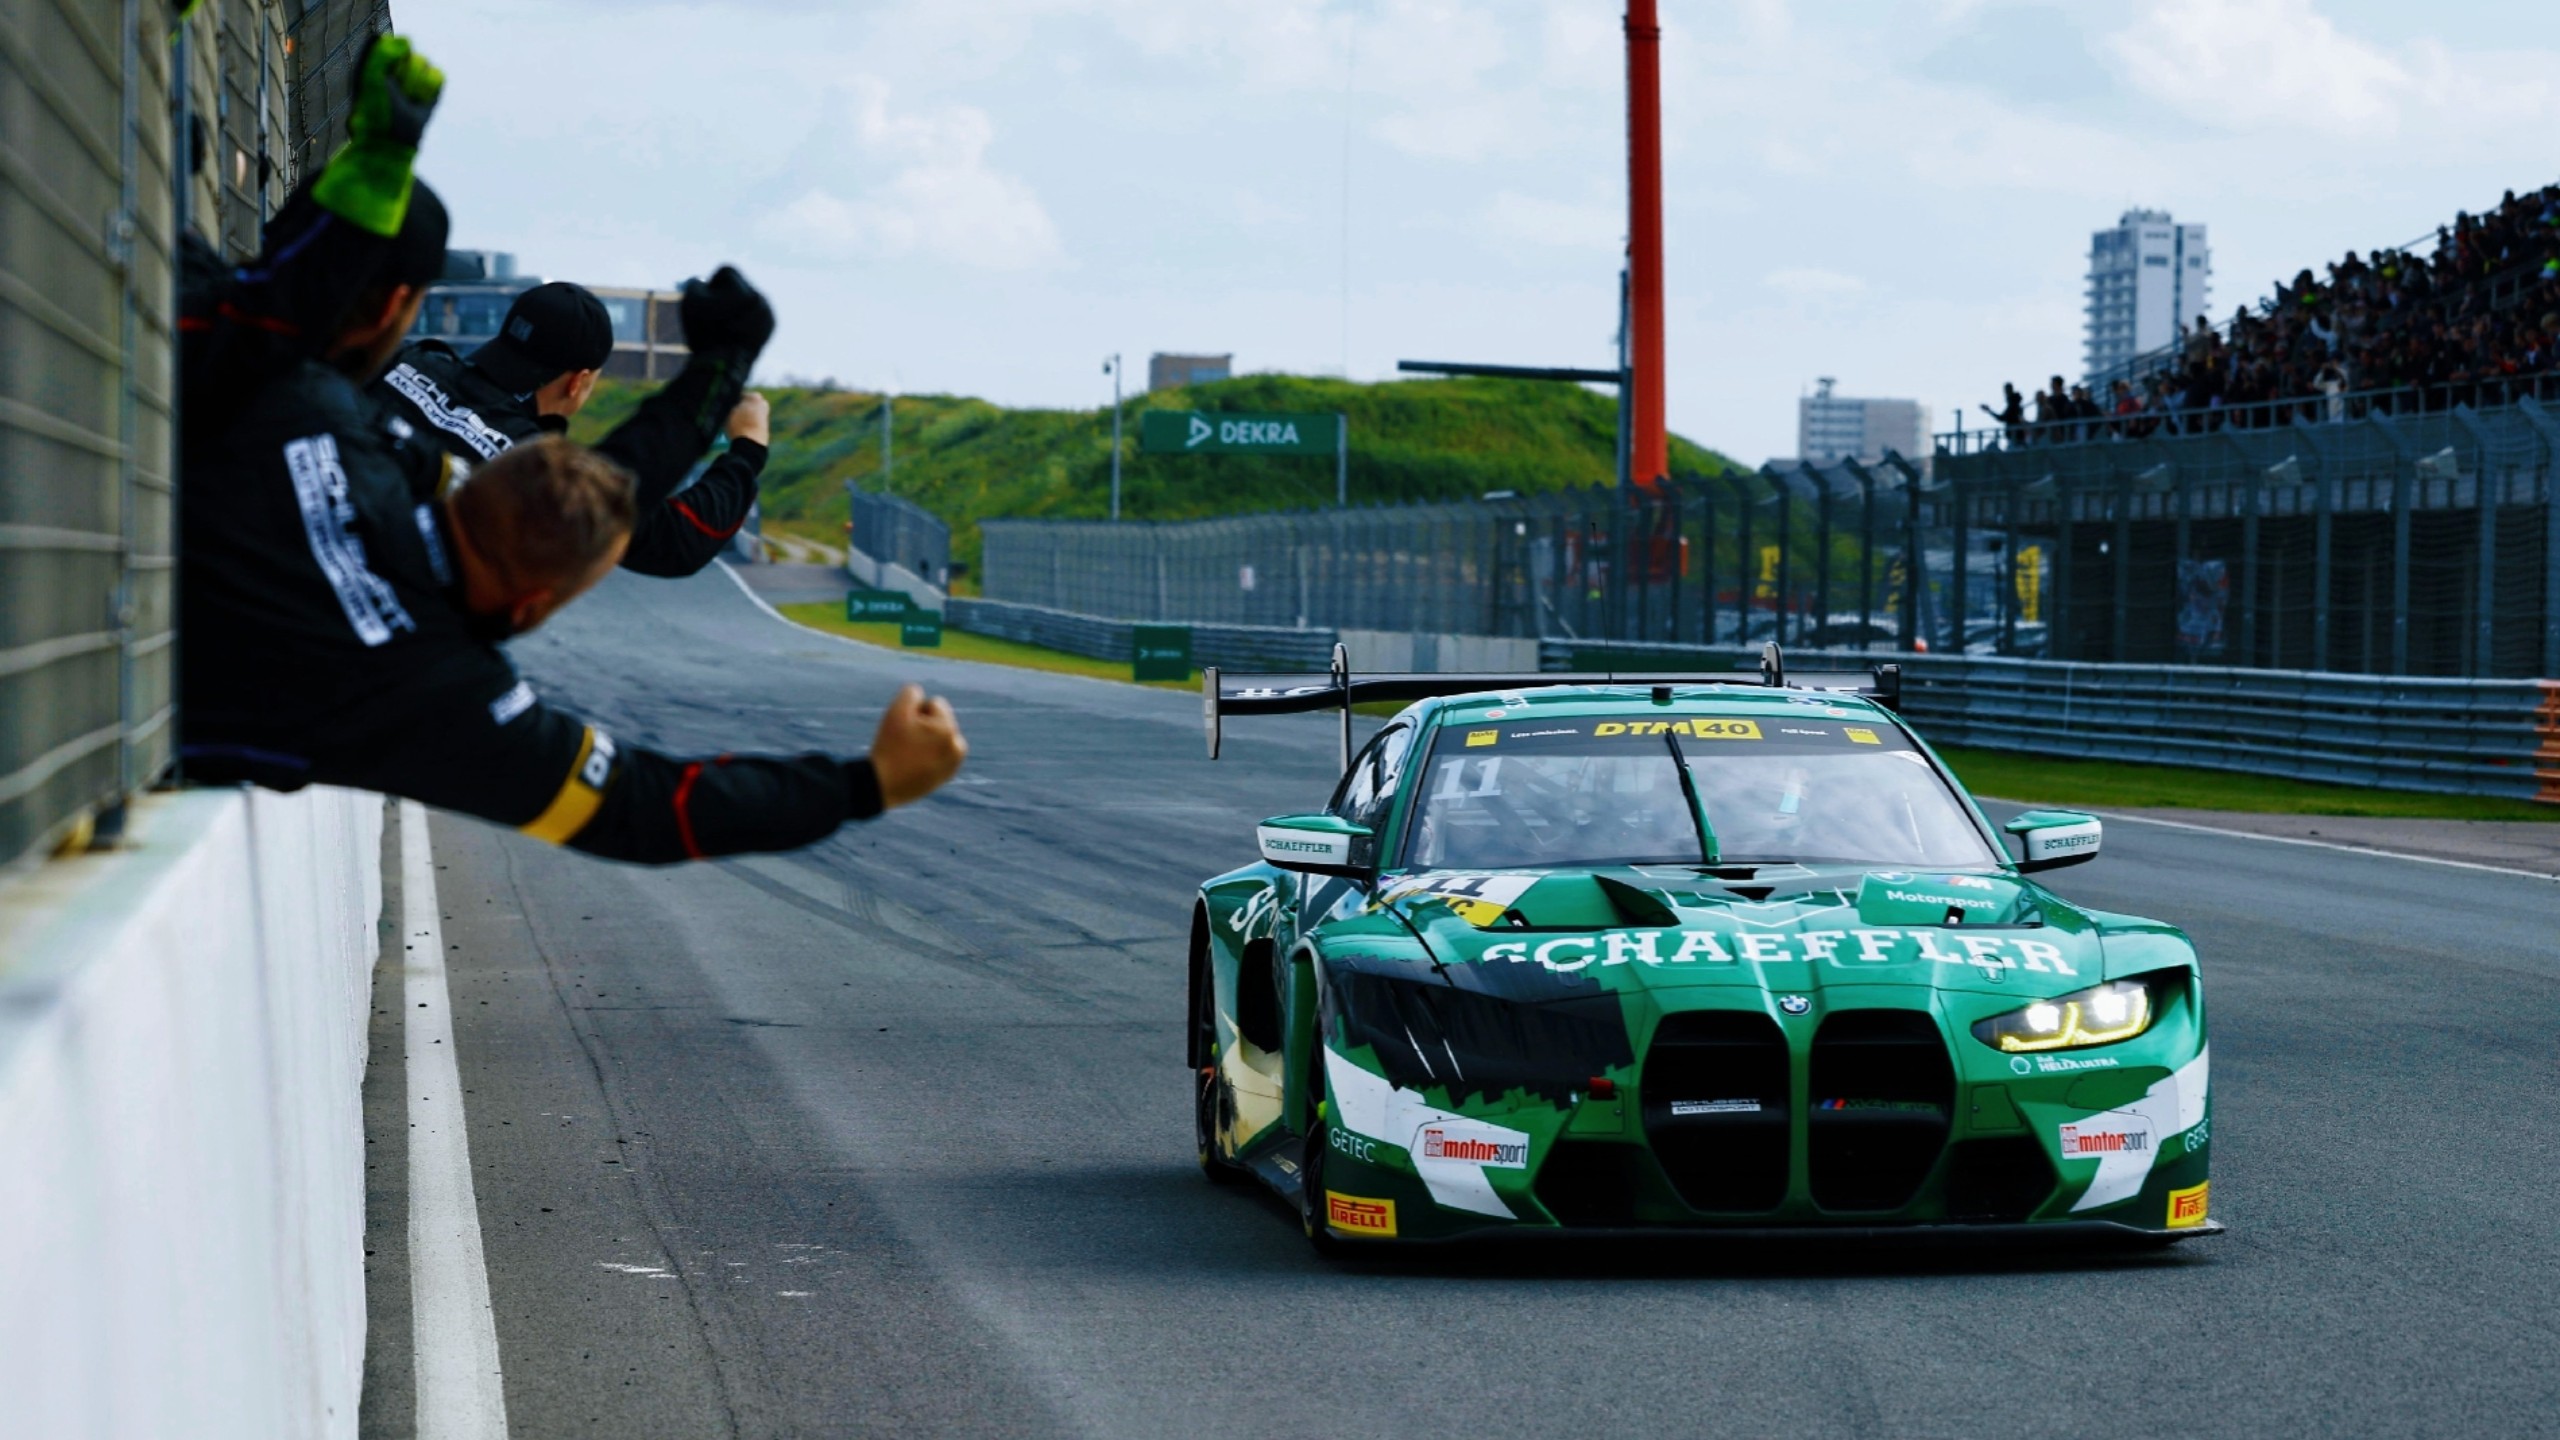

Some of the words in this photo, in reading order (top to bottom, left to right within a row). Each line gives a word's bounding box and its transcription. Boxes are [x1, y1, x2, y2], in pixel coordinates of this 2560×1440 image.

[1220, 420, 1300, 444] DEKRA
[1593, 721, 1692, 737] DTM
[1702, 722, 1751, 736] 40
[1430, 756, 1503, 800] 11
[1264, 839, 1334, 854] SCHAEFFLER
[1886, 889, 1996, 910] Motorsport
[1481, 929, 2077, 977] SCHAEFFLER
[1330, 1127, 1376, 1163] GETEC
[1443, 1139, 1527, 1165] motorsport
[2078, 1129, 2148, 1154] motorsport
[1330, 1197, 1387, 1229] PIRELLI
